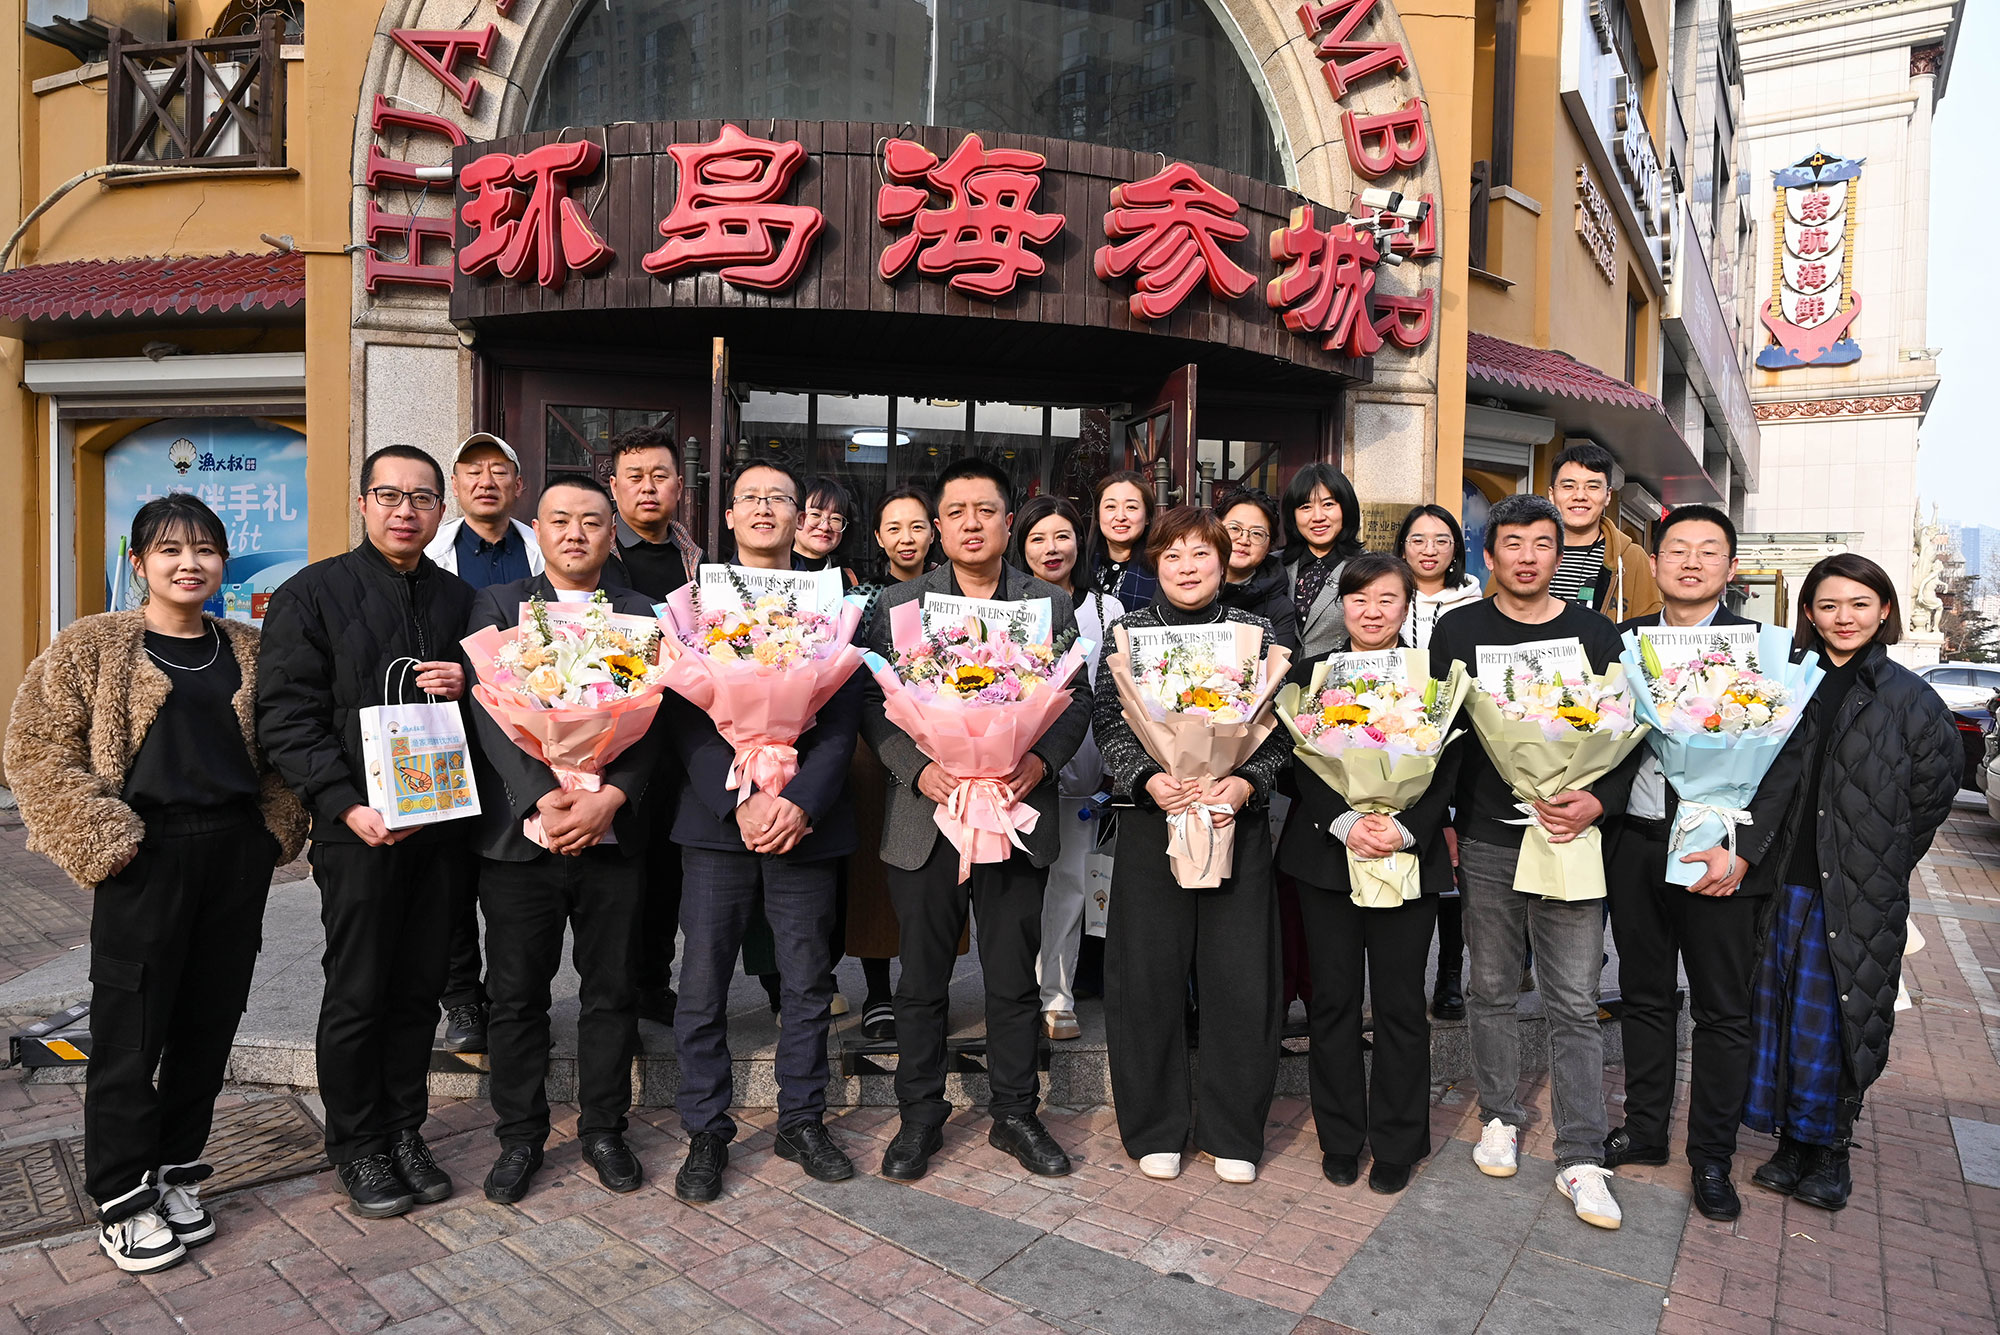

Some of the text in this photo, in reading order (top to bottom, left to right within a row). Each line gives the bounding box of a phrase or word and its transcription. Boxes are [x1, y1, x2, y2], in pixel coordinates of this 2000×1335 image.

[456, 123, 1384, 358] 环岛海参城
[224, 521, 263, 553] ift
[705, 572, 737, 584] PRET
[928, 600, 962, 616] PRETTY
[1130, 634, 1159, 647] ETTY
[1202, 630, 1232, 642] STUDIO
[1480, 652, 1512, 664] PRETTY
[1547, 645, 1577, 658] STUDIO
